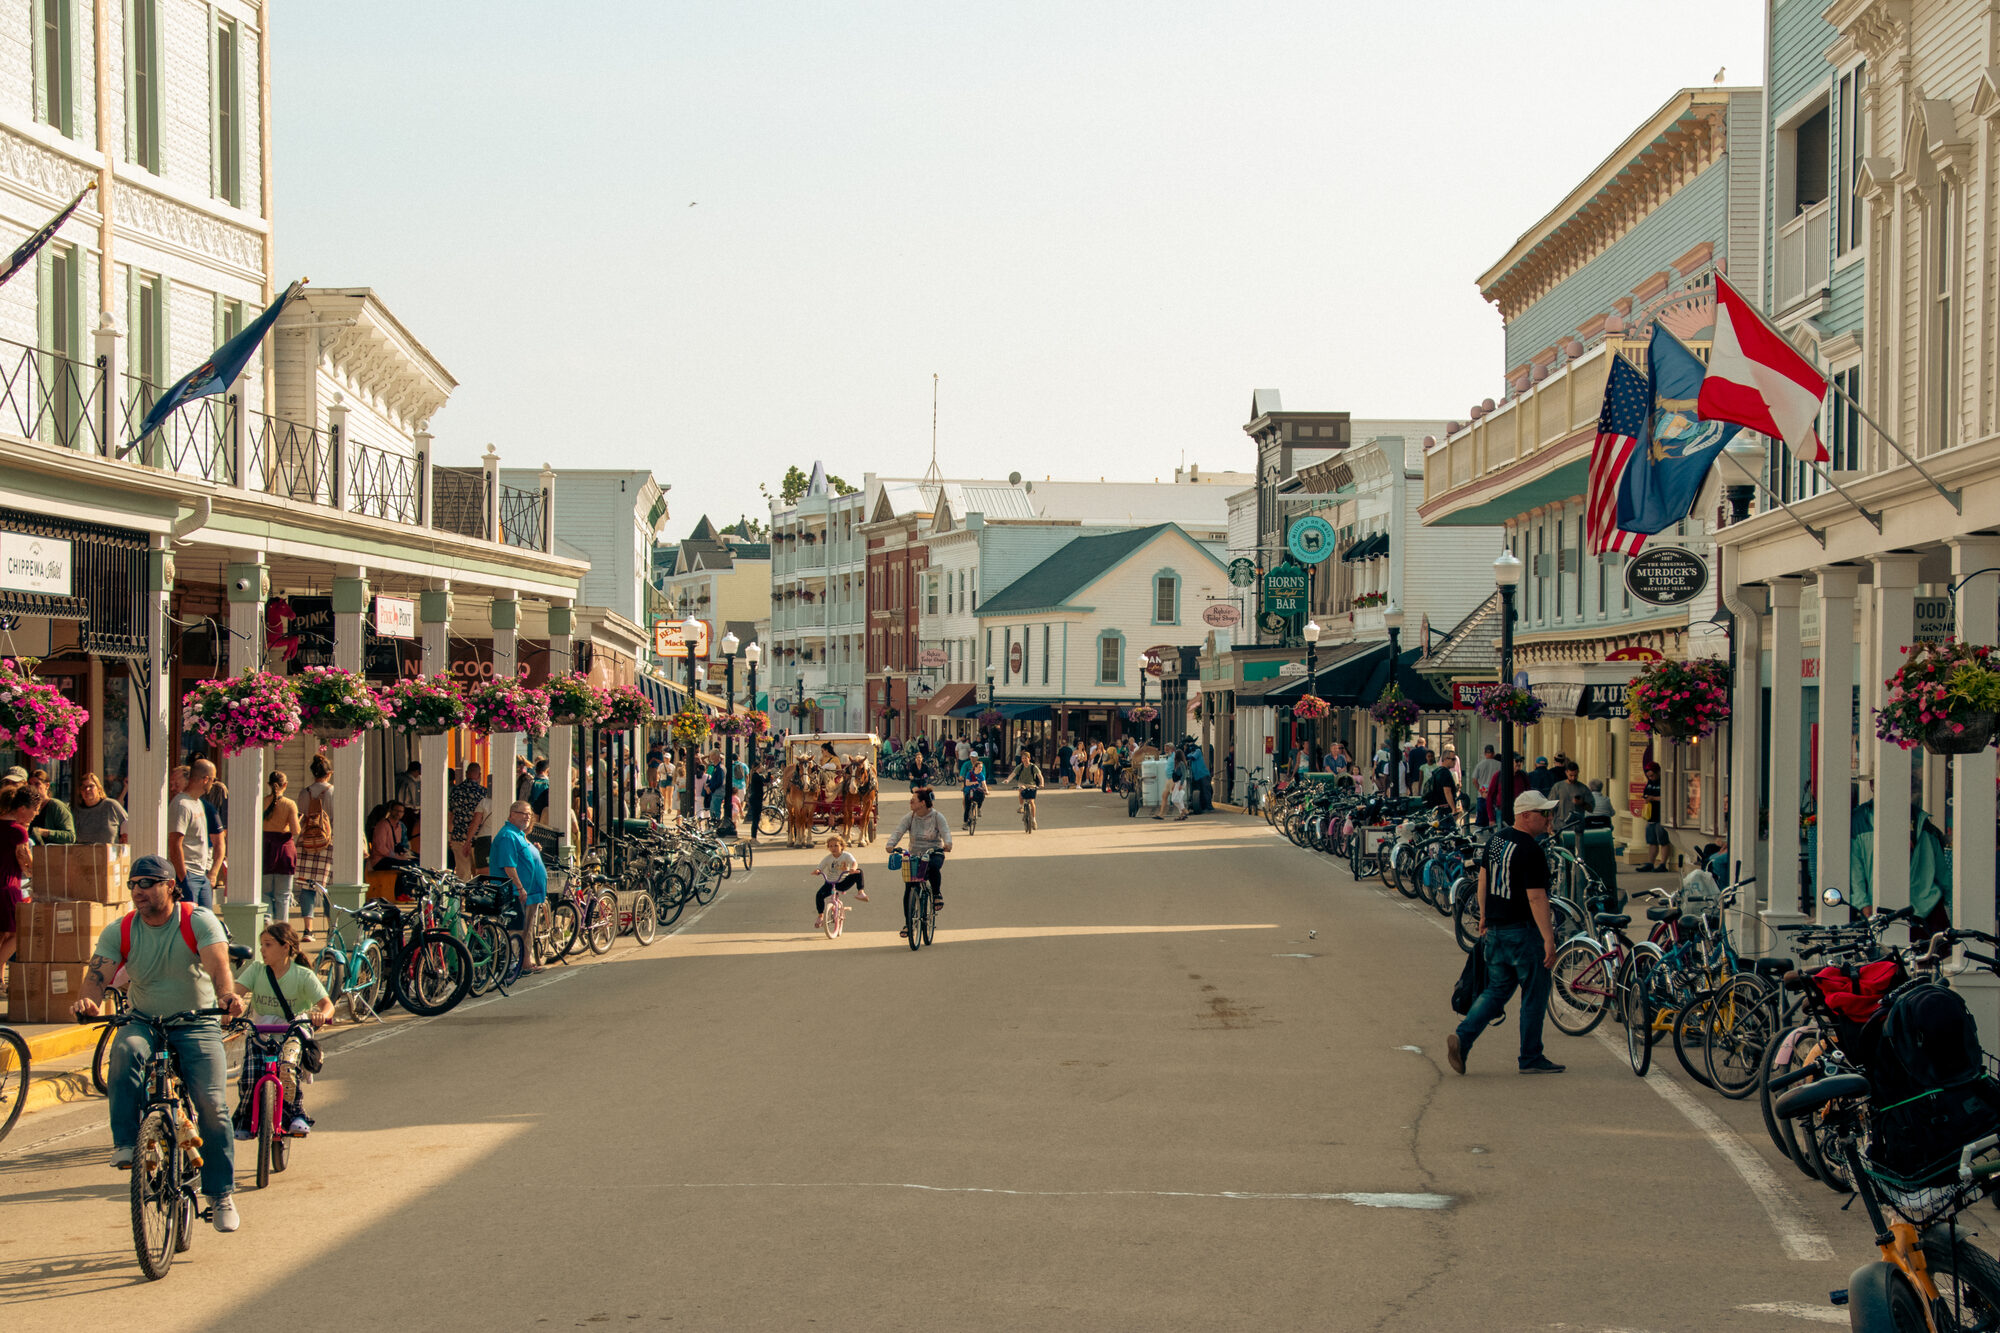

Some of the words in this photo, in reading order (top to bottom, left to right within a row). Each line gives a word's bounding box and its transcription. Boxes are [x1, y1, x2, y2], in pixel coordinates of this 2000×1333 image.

[8, 557, 44, 578] CHIPPEWA
[1637, 568, 1697, 577] MURDICK'S
[1268, 576, 1304, 587] HORN'S
[1649, 577, 1686, 586] FUDGE
[1276, 599, 1296, 609] BAR
[380, 605, 393, 624] PINK
[399, 607, 411, 626] PONY
[1916, 603, 1946, 619] OOD
[296, 609, 329, 627] PINK
[1609, 707, 1628, 715] THE
